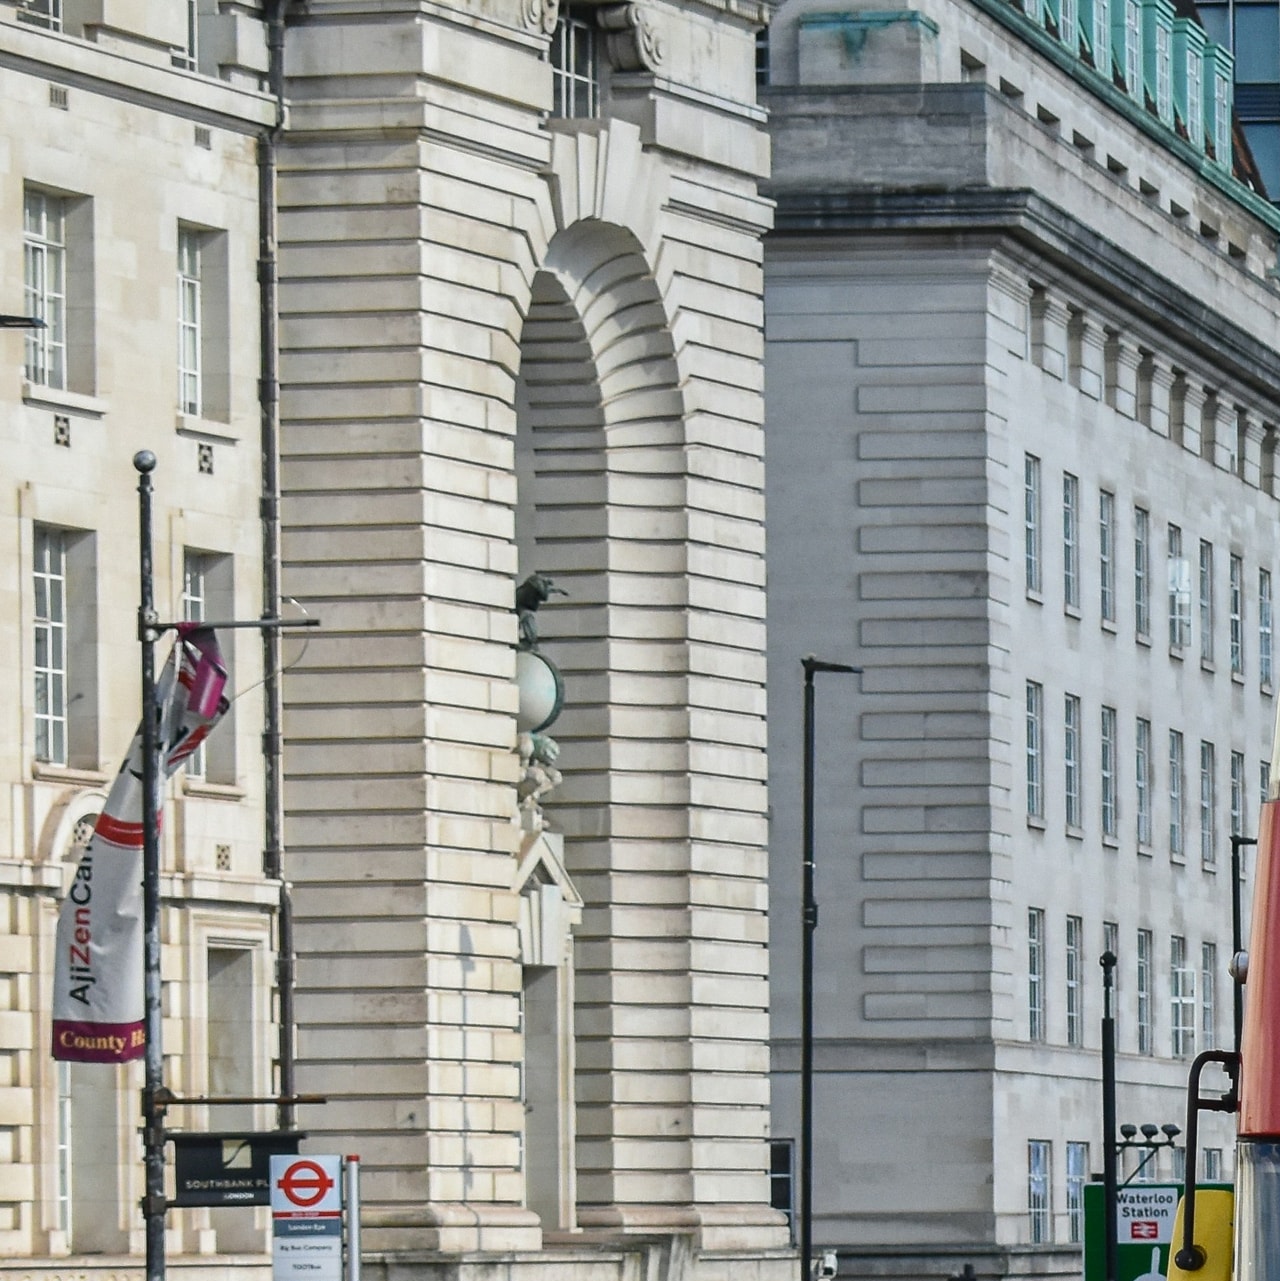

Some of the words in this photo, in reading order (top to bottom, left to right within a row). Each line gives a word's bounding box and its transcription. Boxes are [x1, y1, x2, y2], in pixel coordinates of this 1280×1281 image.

[59, 1031, 127, 1054] County
[131, 1031, 146, 1048] Ha
[1117, 1193, 1173, 1205] Waterloo
[1122, 1206, 1169, 1218] Station
